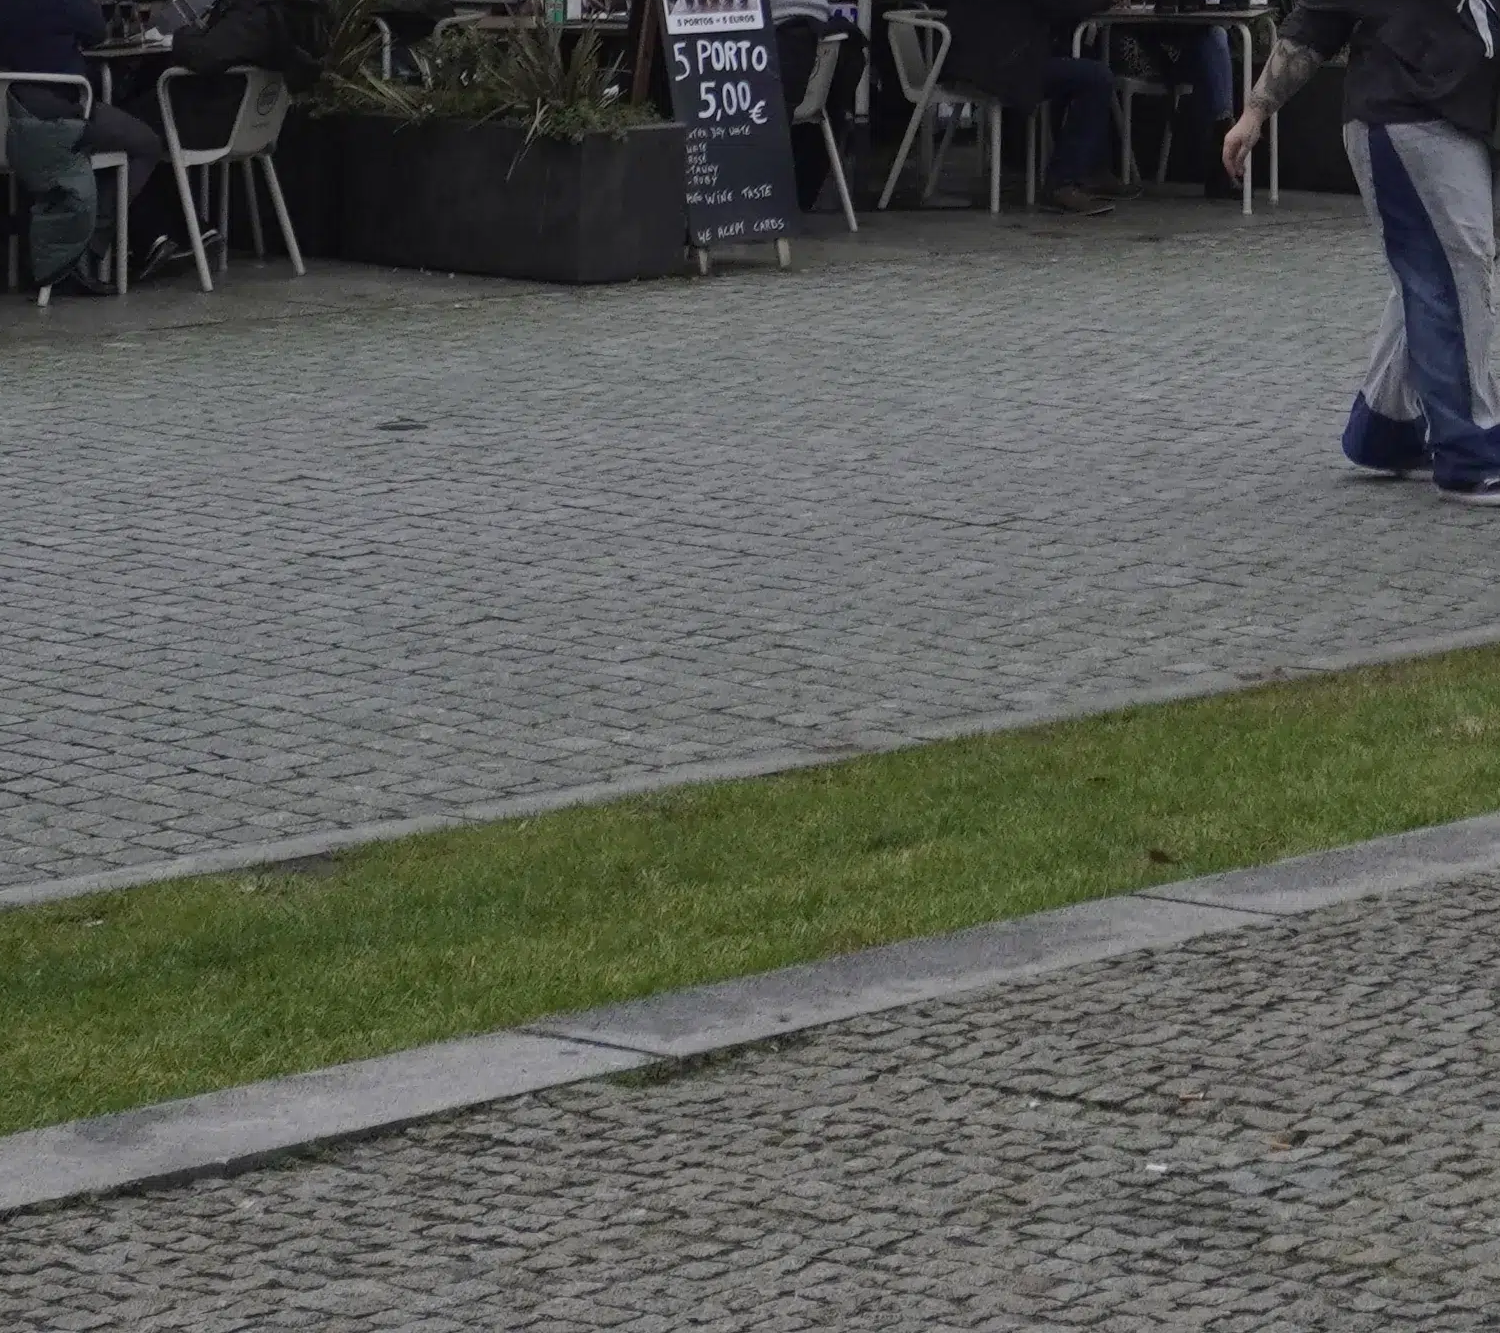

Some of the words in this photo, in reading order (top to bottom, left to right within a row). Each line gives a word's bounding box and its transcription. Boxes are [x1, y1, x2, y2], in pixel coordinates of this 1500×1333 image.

[683, 17, 713, 27] PORTOS
[729, 15, 755, 24] EUROS
[673, 41, 691, 82] 5
[696, 39, 768, 75] PORTO
[740, 183, 773, 200] TASTE
[753, 217, 785, 232] CARDS
